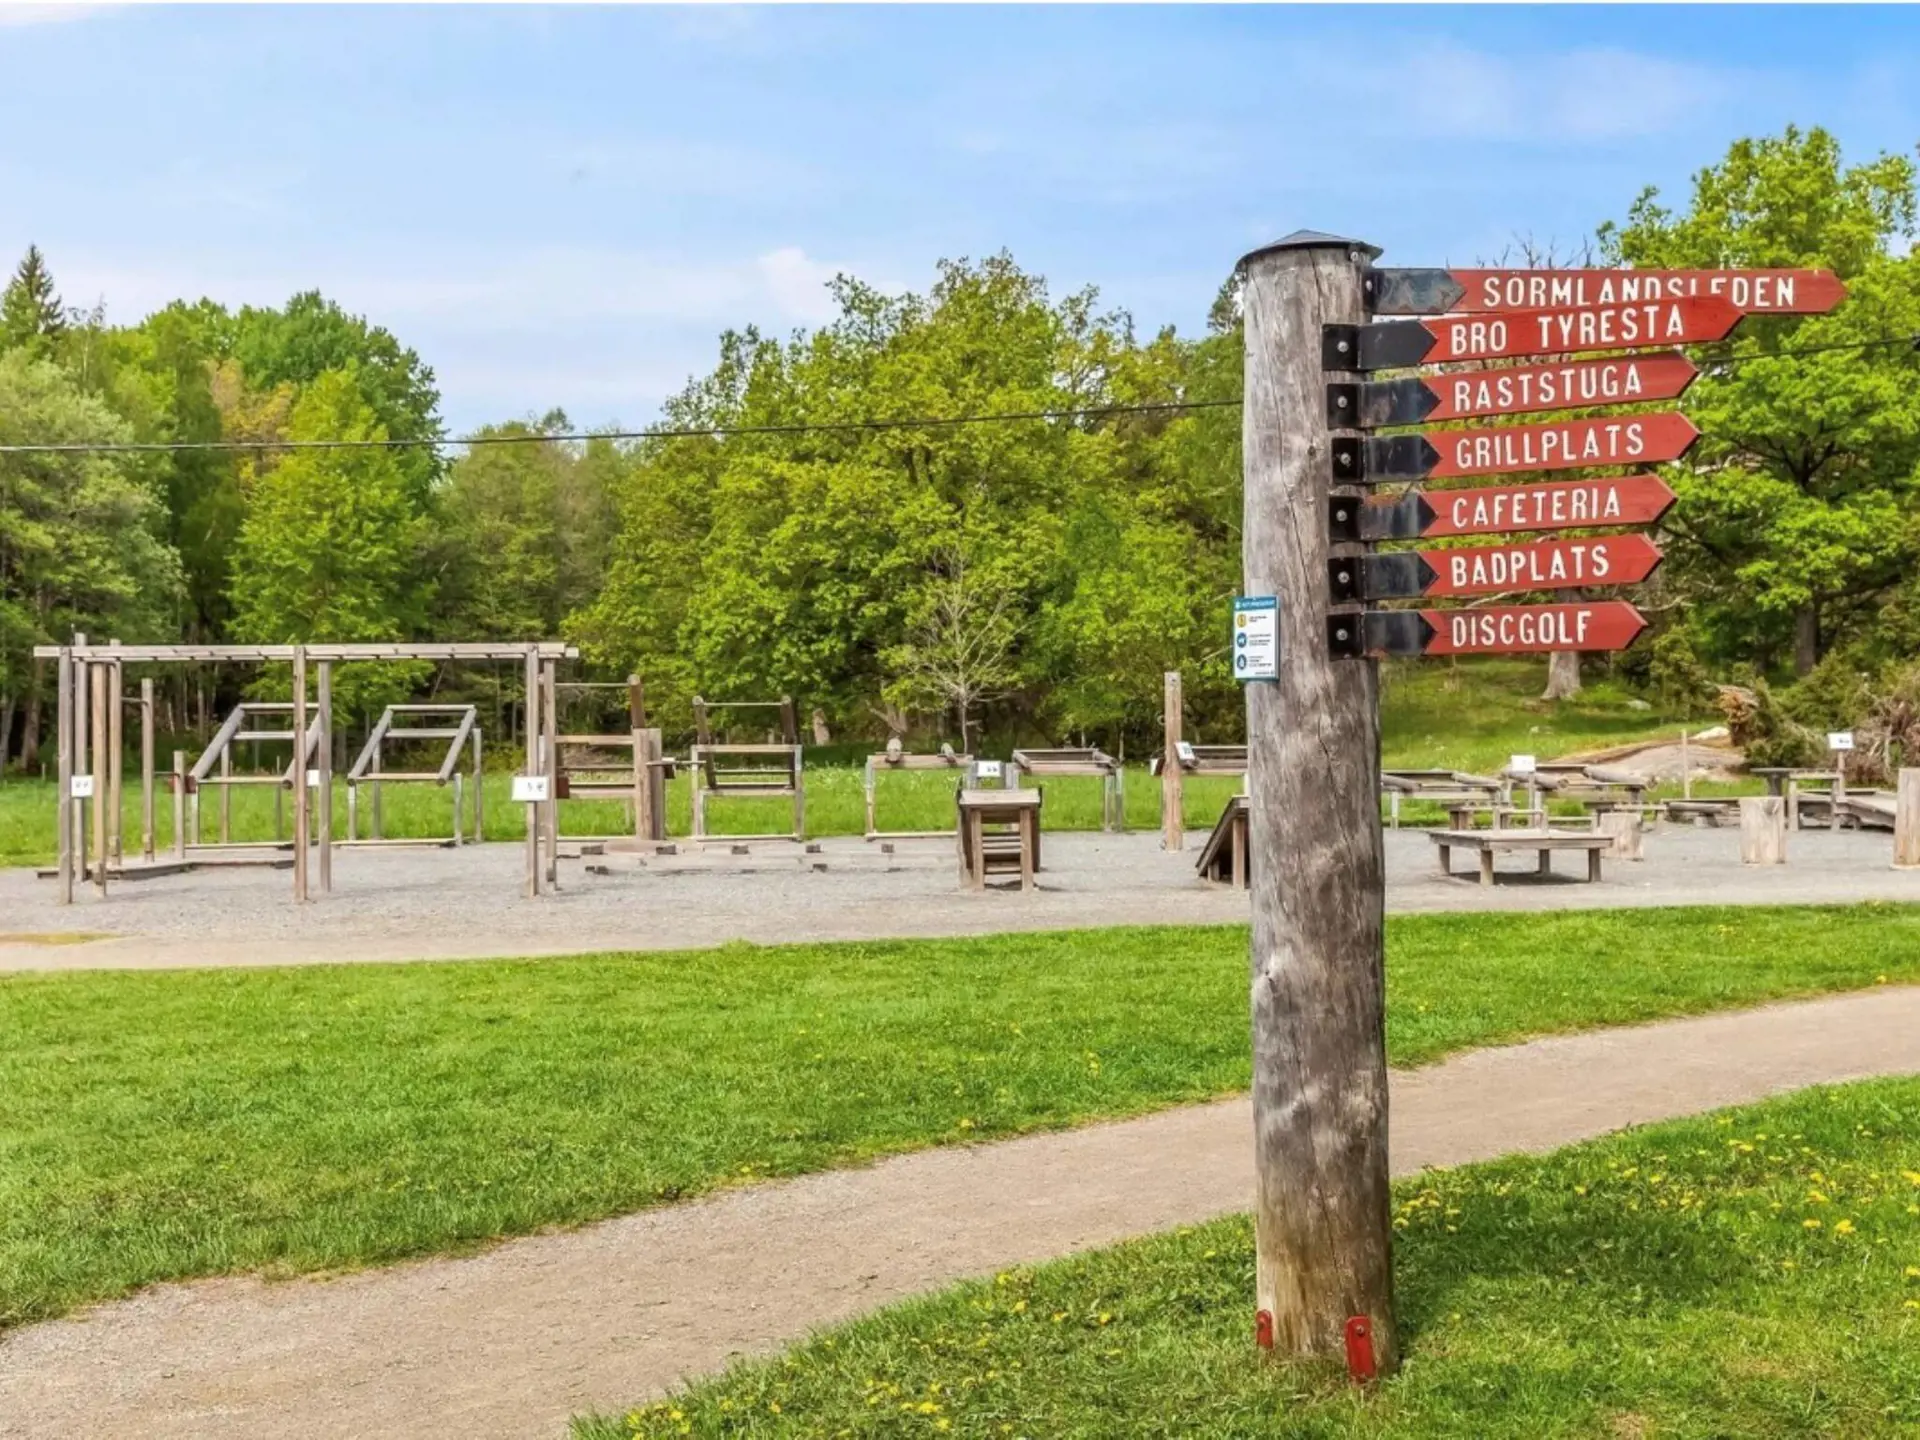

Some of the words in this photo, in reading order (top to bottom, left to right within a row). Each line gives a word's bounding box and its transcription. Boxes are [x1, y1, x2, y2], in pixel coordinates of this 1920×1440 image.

[1451, 320, 1508, 356] BRO
[1537, 304, 1685, 348] TYRESTA
[1454, 363, 1642, 413] RASTSTUGA
[1456, 423, 1644, 470] GRILLPLATS
[1452, 486, 1622, 530] CAFETERIA
[1451, 544, 1610, 588] BADPLATS
[1452, 610, 1593, 649] DISCGOLF
